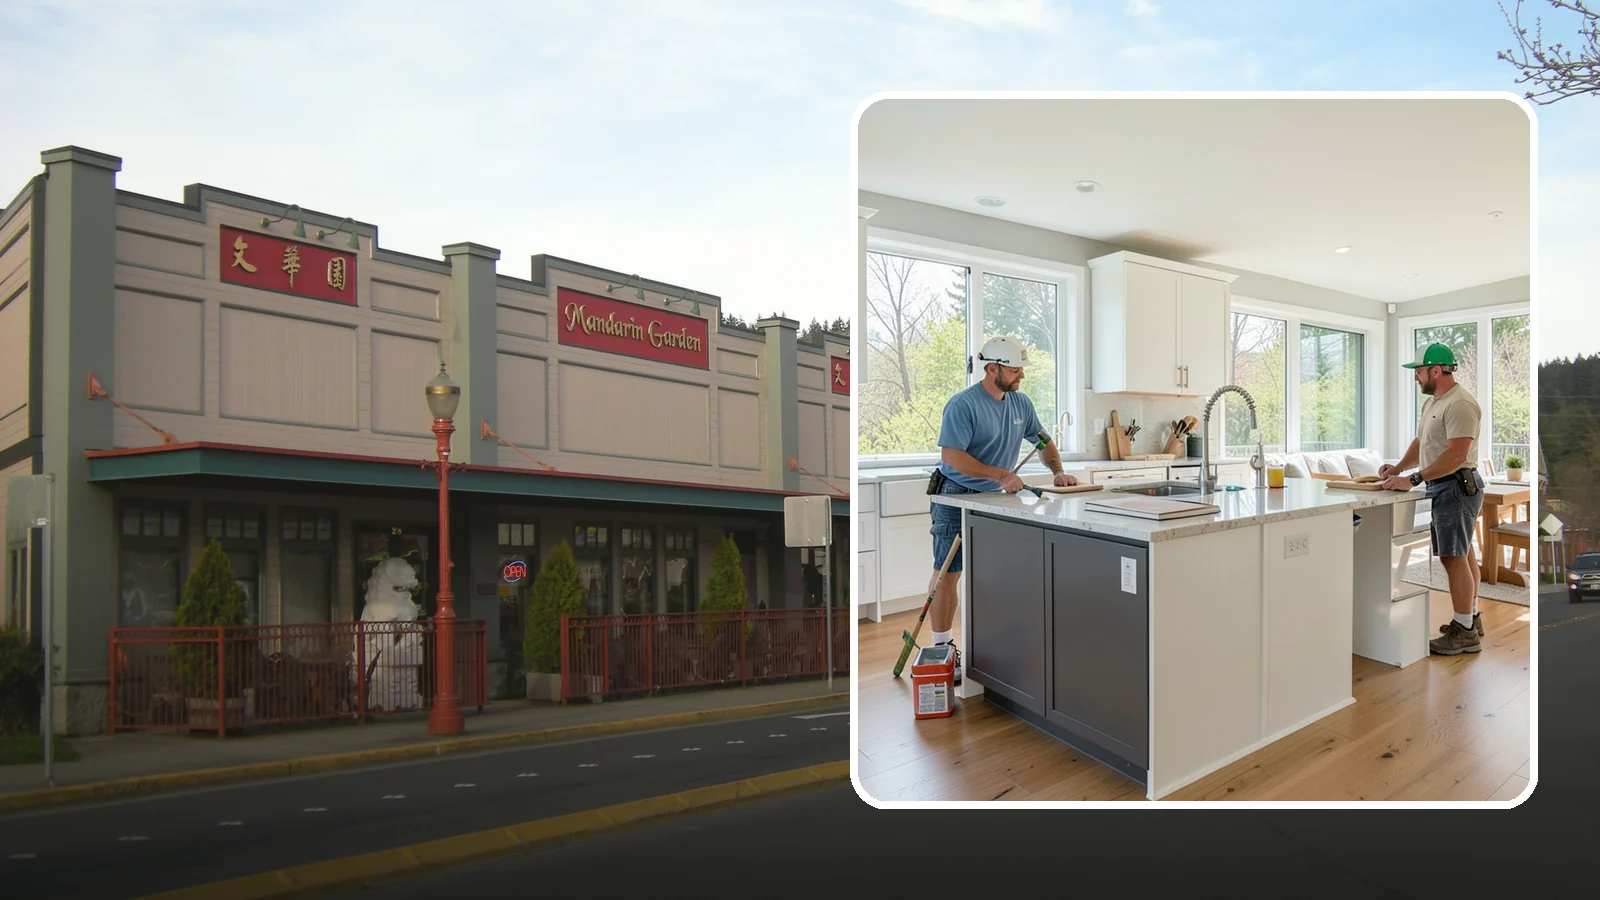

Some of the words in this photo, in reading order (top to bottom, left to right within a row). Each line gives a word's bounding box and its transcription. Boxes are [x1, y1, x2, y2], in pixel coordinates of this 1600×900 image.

[564, 302, 644, 341] Mandarin
[648, 320, 701, 352] Garden
[503, 565, 527, 578] OPEN
